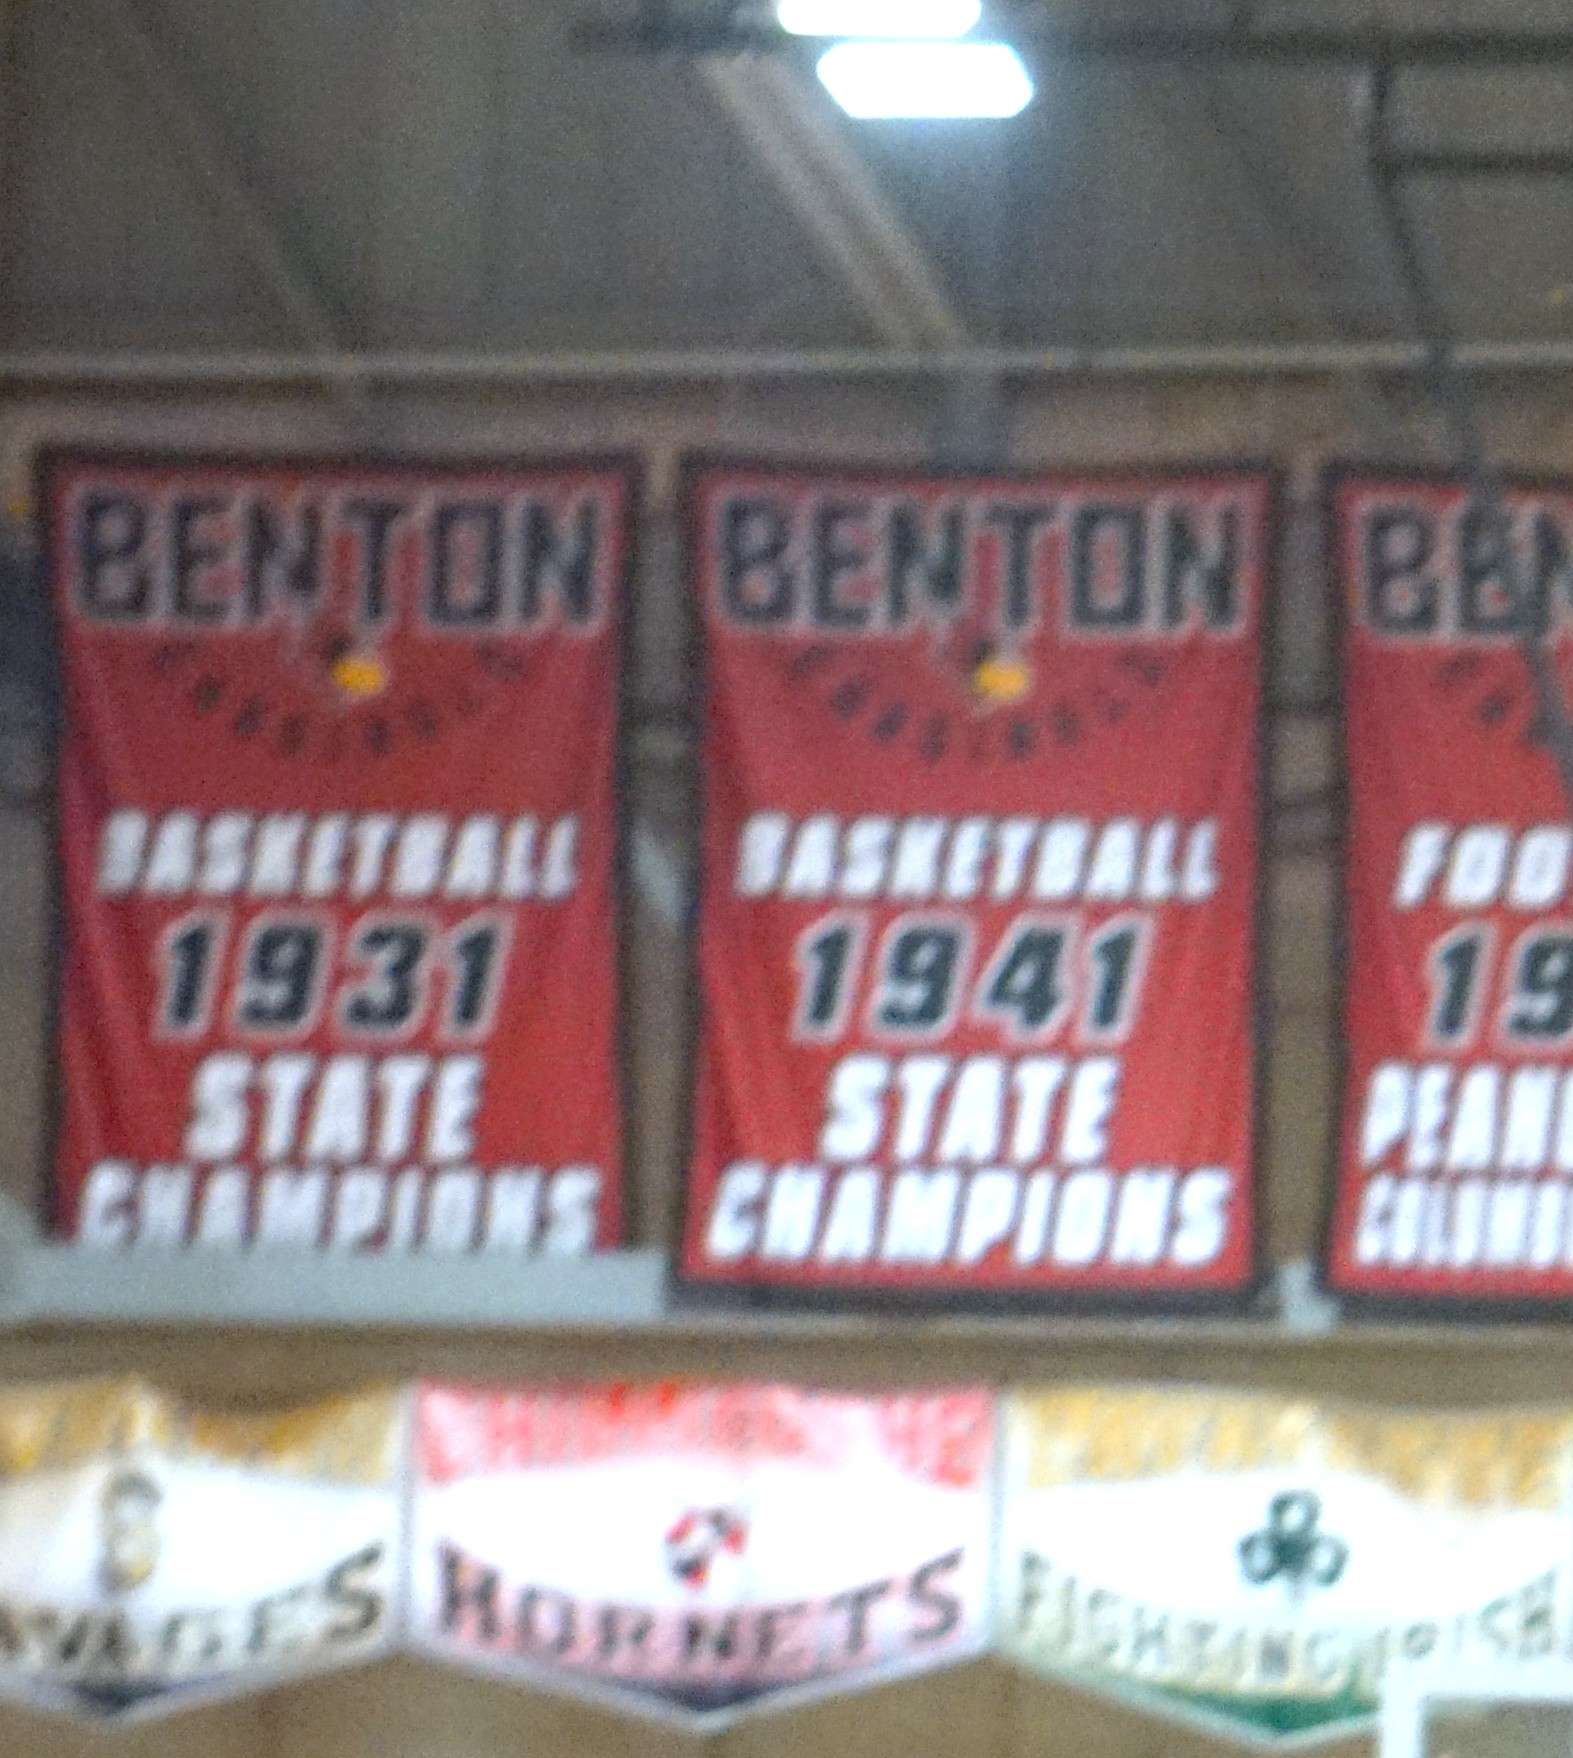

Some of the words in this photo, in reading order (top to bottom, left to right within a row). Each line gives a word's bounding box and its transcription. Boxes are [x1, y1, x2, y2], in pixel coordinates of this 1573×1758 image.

[69, 476, 610, 637] BENTON
[709, 486, 1250, 642] BENTON
[97, 810, 580, 902] BASKETBALL
[735, 813, 1222, 903] BASKETBALL
[153, 911, 515, 1046] 1931
[791, 910, 1157, 1046] 1941
[184, 1051, 487, 1164] STATE
[819, 1054, 1127, 1165] STATE
[72, 1162, 603, 1260] CHAMPIONS
[703, 1161, 1234, 1270] CHAMPIONS
[435, 1537, 967, 1664] HORNETS
